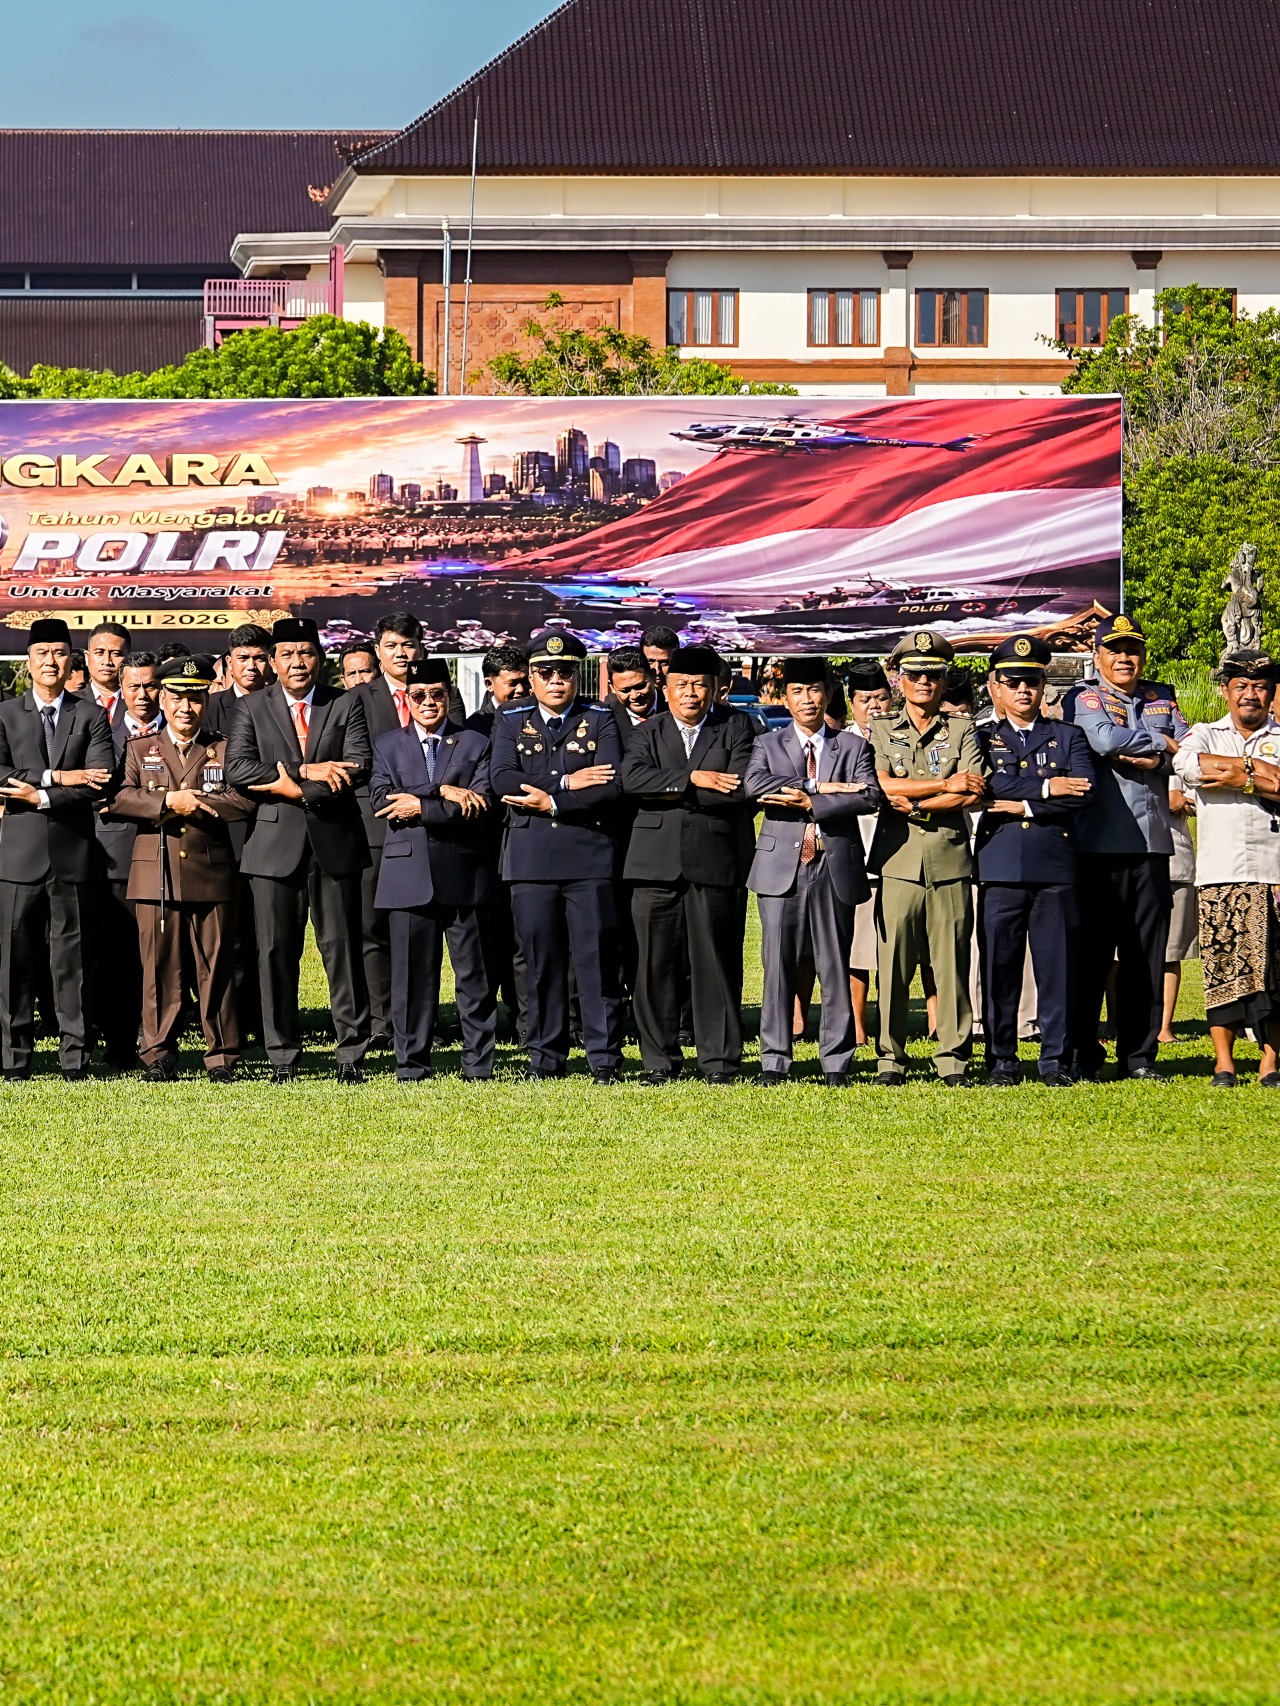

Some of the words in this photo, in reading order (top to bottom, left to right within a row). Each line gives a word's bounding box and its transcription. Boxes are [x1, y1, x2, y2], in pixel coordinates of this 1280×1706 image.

[26, 511, 120, 526] Tahun
[129, 508, 286, 529] Mengabdi
[12, 530, 288, 572] POLRI
[7, 584, 100, 599] Untuk
[107, 584, 276, 601] Masyarakat
[898, 604, 950, 614] POLISI
[73, 615, 84, 625] 1
[102, 614, 152, 625] JULI
[161, 613, 230, 625] 2026
